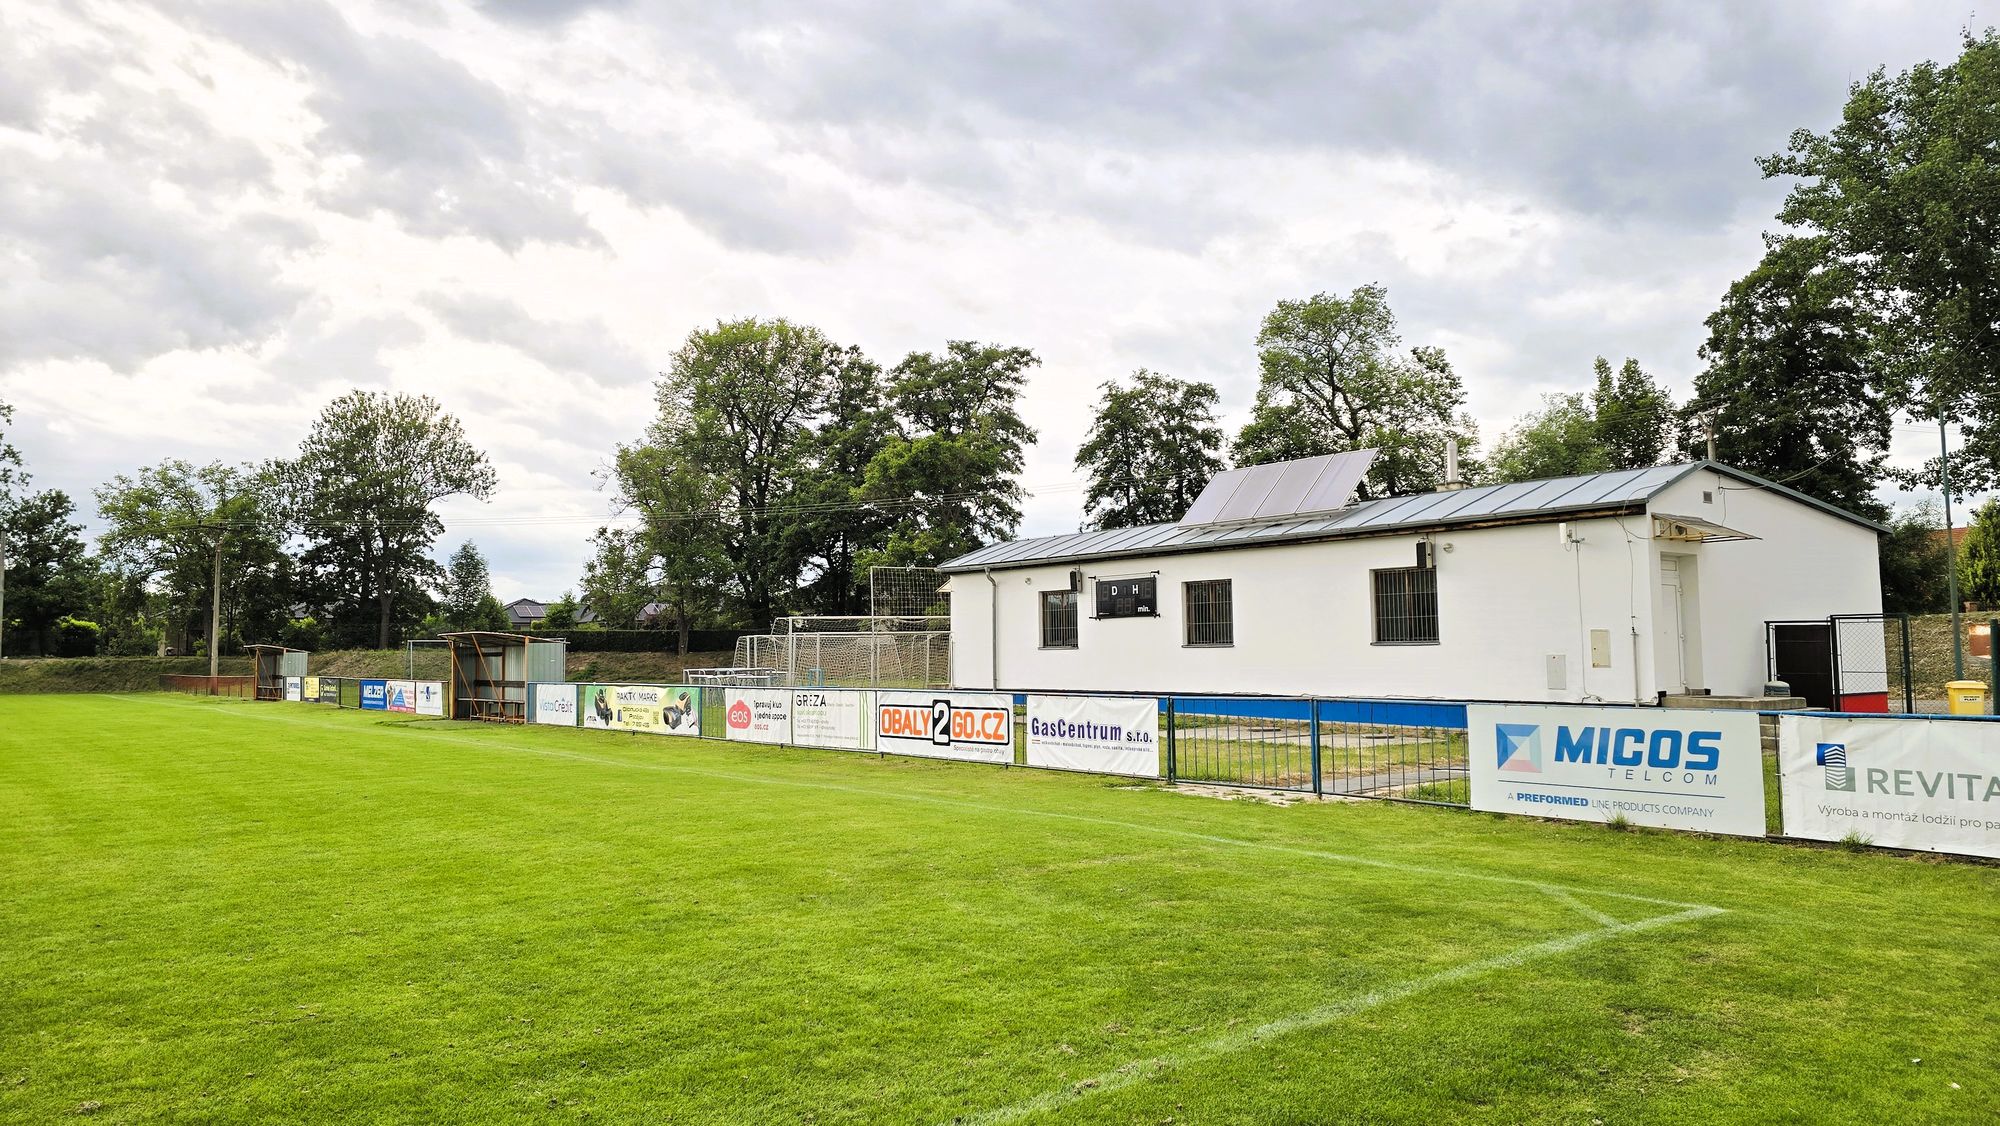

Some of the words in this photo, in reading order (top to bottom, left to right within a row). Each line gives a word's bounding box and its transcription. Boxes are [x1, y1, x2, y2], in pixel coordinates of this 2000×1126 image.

[1112, 586, 1118, 595] D
[1132, 585, 1138, 594] H
[731, 710, 748, 723] eos
[881, 702, 1005, 743] OBALY2GO.CZ
[1031, 717, 1122, 741] GasCentrum
[1126, 731, 1153, 743] s.r.o.
[1554, 726, 1722, 771] MICOS
[1608, 767, 1718, 786] TELCOM
[1507, 791, 1514, 801] A
[1516, 792, 1589, 807] PREFORMED
[1591, 799, 1610, 810] LINE
[1612, 801, 1661, 814] PRODUCTS
[1662, 805, 1716, 818] COMPANY
[1817, 804, 1859, 818] Výroba
[1872, 811, 1919, 823] montáž
[1922, 813, 1956, 826] lodžií
[1960, 818, 1982, 830] pro
